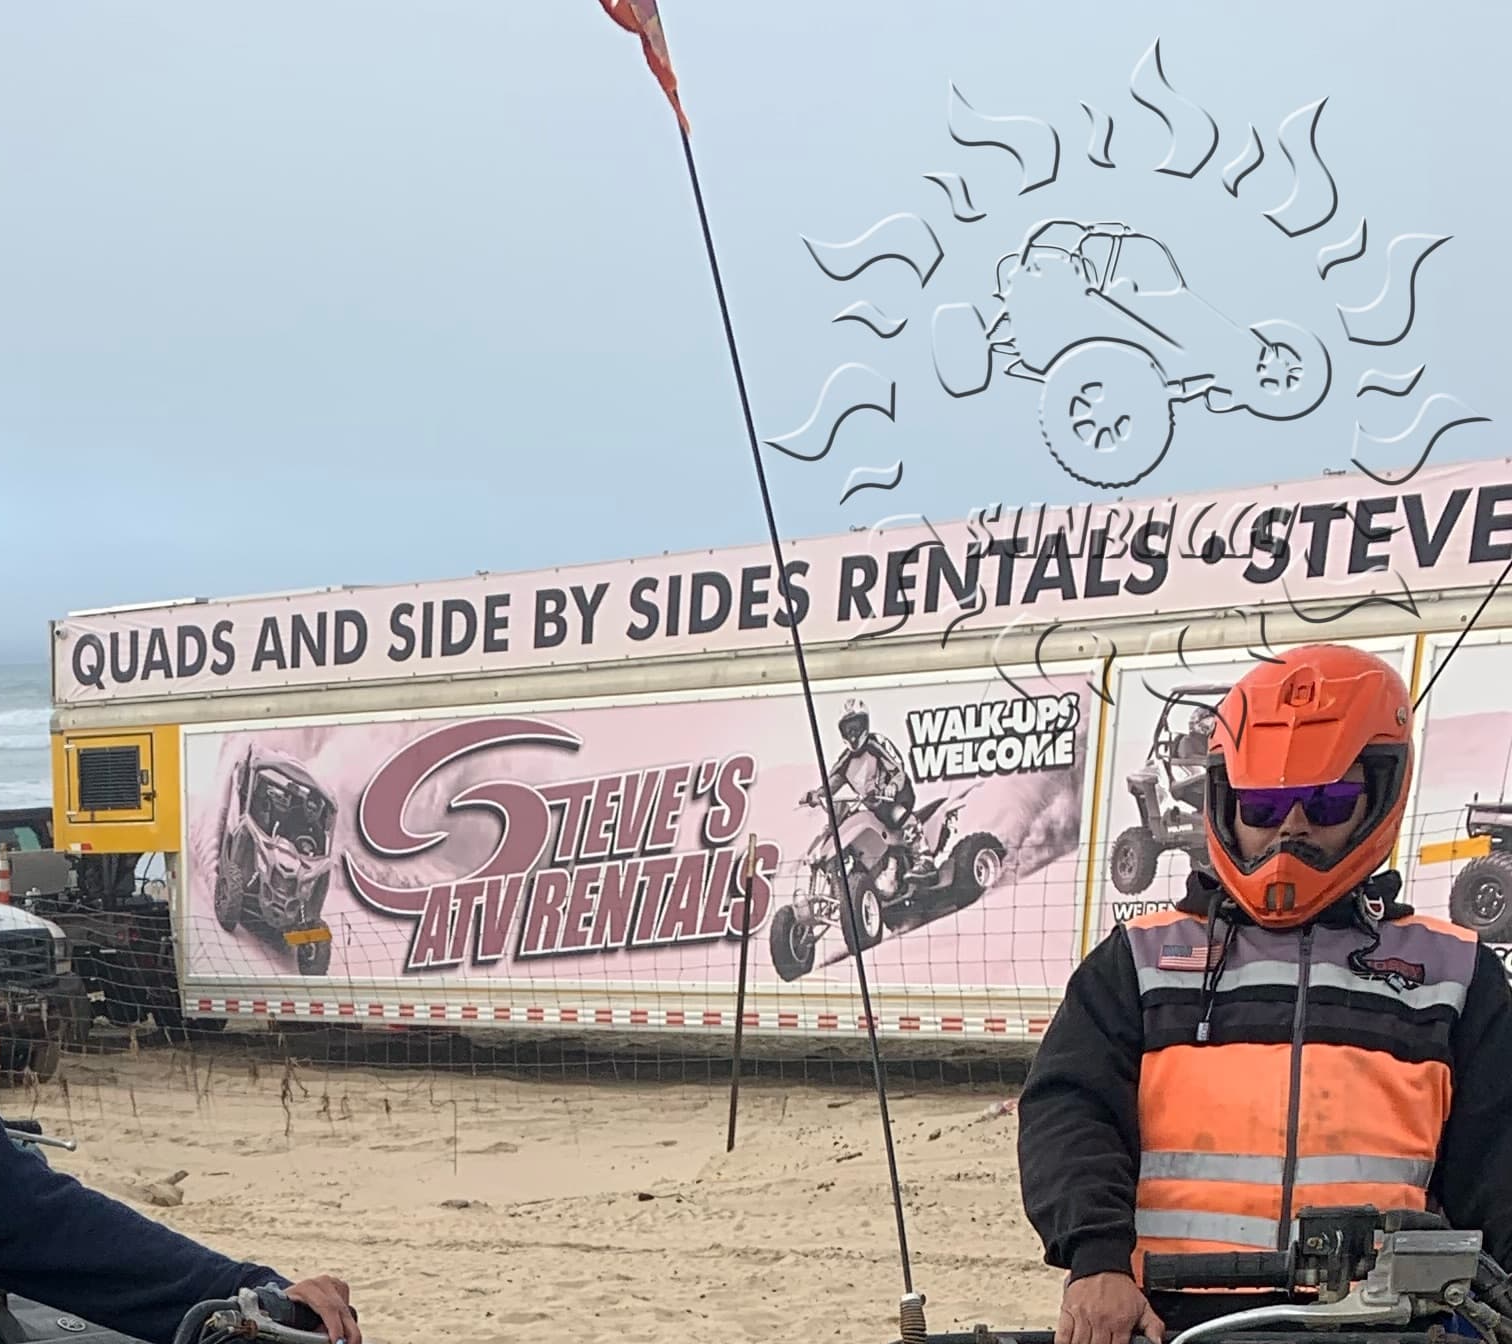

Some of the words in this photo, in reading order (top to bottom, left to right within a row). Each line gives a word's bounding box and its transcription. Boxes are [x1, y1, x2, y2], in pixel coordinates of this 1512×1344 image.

[71, 619, 236, 690] QUADS
[251, 609, 368, 673] AND
[387, 593, 511, 663] SIDE
[533, 582, 611, 650] BY
[625, 560, 811, 642] SIDES
[837, 520, 1172, 622] RENTALS
[907, 692, 1081, 745] WALK-UPS
[910, 730, 1076, 782] WELCOME
[343, 716, 757, 914] STEVE'S
[406, 871, 533, 970] ATV
[519, 841, 782, 957] RENTALS
